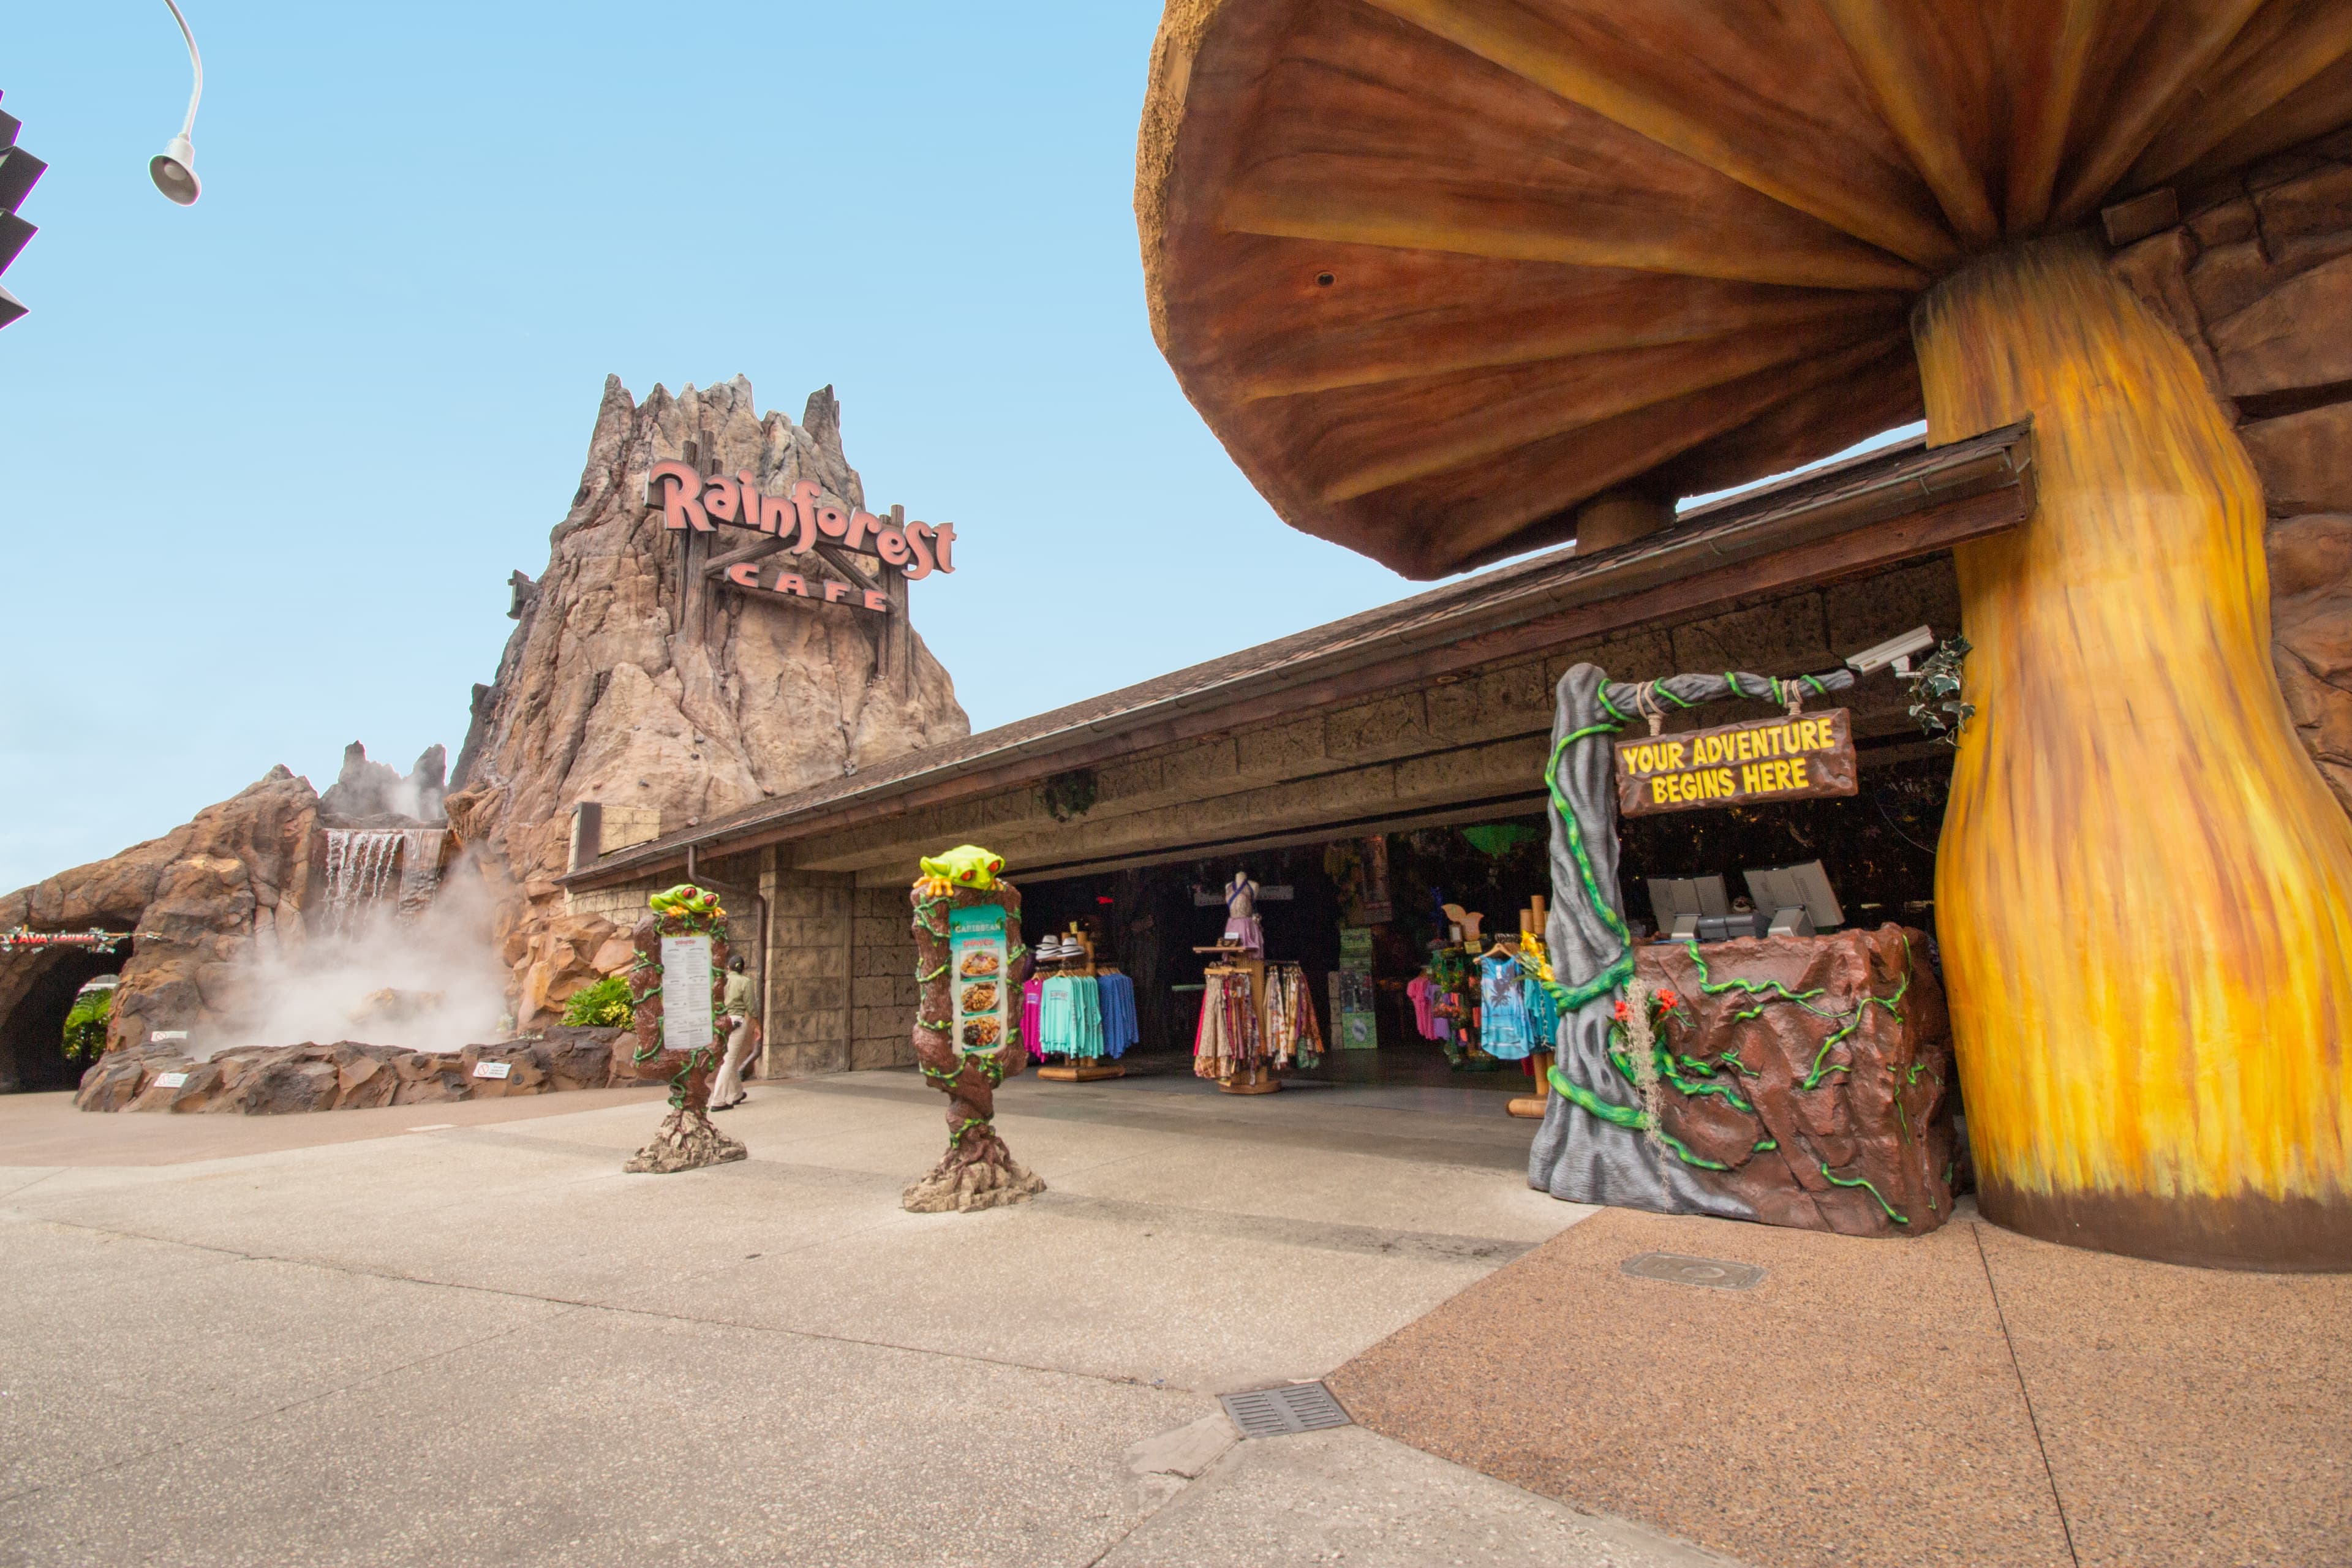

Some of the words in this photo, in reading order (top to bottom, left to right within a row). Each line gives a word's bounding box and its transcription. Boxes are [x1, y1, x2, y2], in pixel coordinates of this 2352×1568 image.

[646, 459, 957, 580] Rainforest
[728, 562, 887, 612] CAFE
[1622, 742, 1684, 774] YOUR
[1693, 718, 1835, 766] ADVENTURE
[1652, 769, 1735, 804] BEGINS
[1743, 758, 1809, 794] HERE
[9, 933, 48, 944] LAVA
